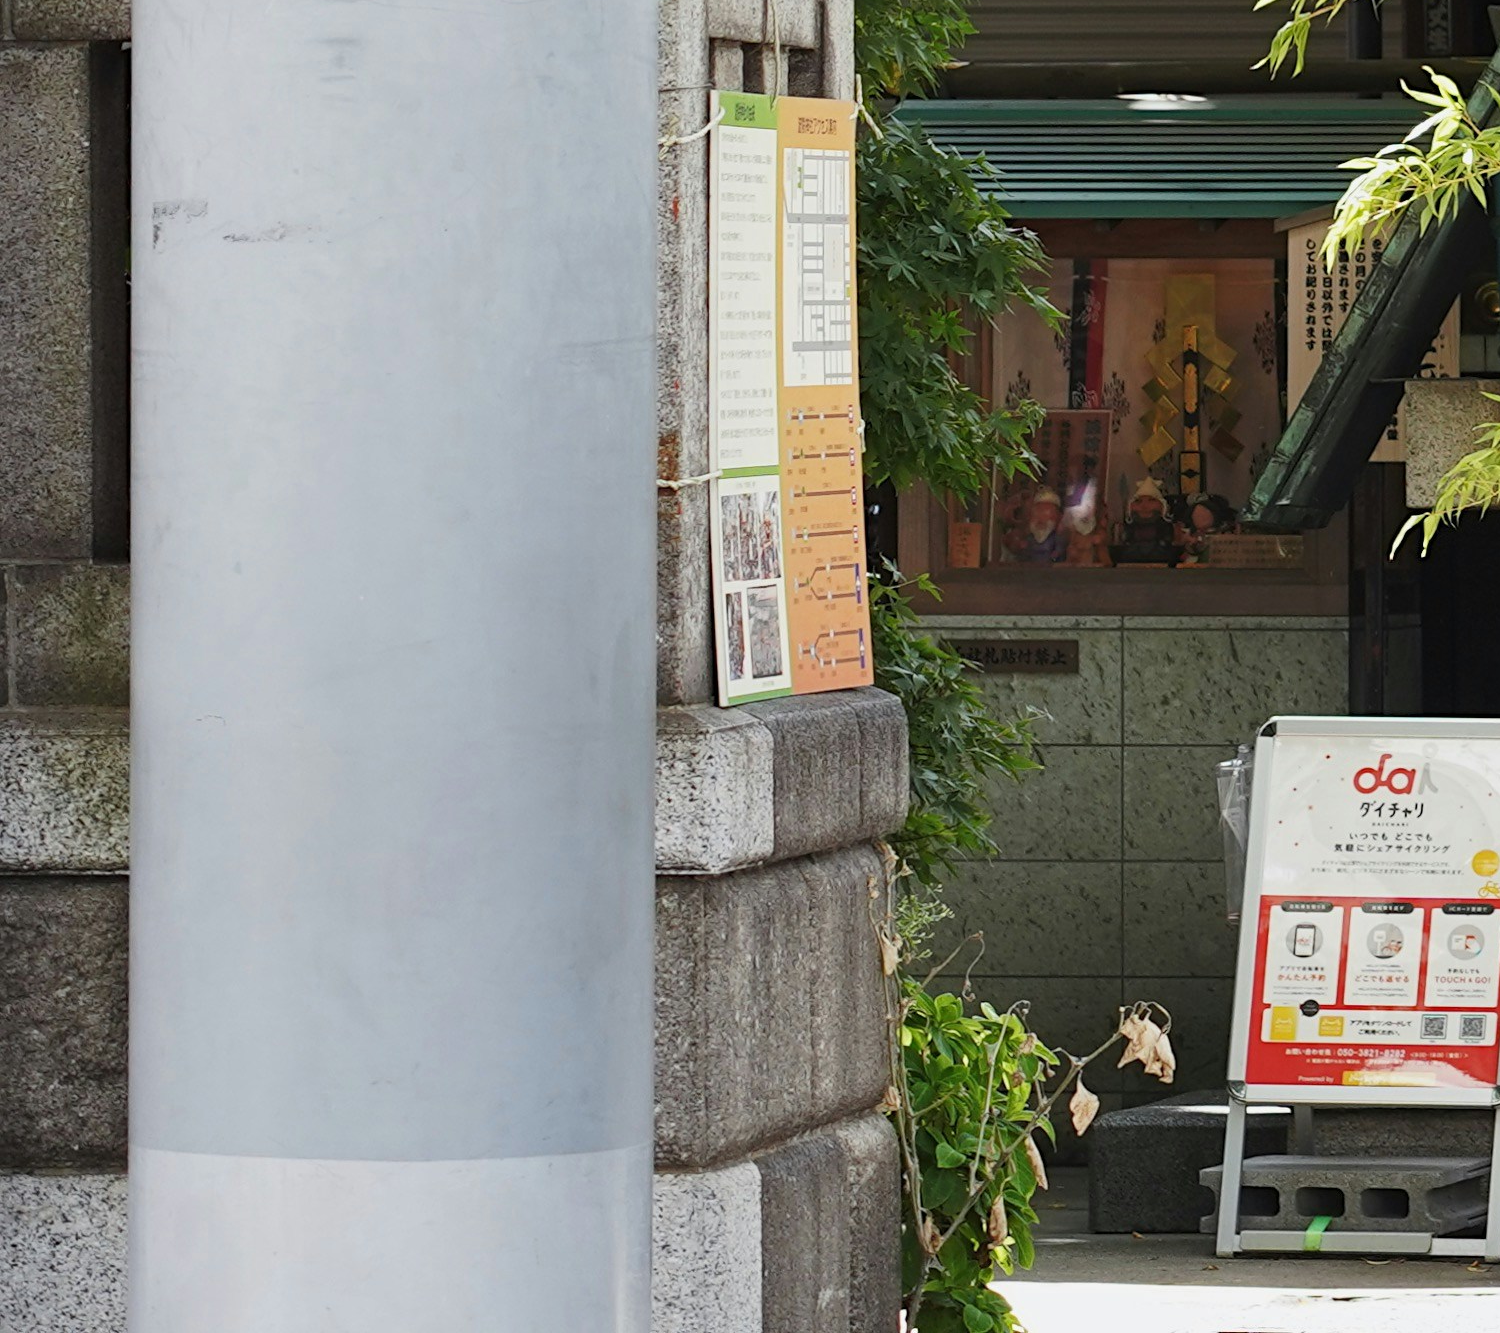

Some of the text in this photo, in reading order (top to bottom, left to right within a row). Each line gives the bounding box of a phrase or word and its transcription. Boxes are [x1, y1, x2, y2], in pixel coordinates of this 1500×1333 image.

[1359, 800, 1425, 819] ダイチャリ
[1349, 833, 1434, 842] いつでも どこでも
[1333, 842, 1451, 854] 気軽にシェアサイクリング
[1277, 974, 1327, 982] かんたん予約
[1354, 974, 1410, 983] どこでも返せる
[1435, 976, 1466, 984] TOUCH
[1474, 976, 1492, 984] GO!
